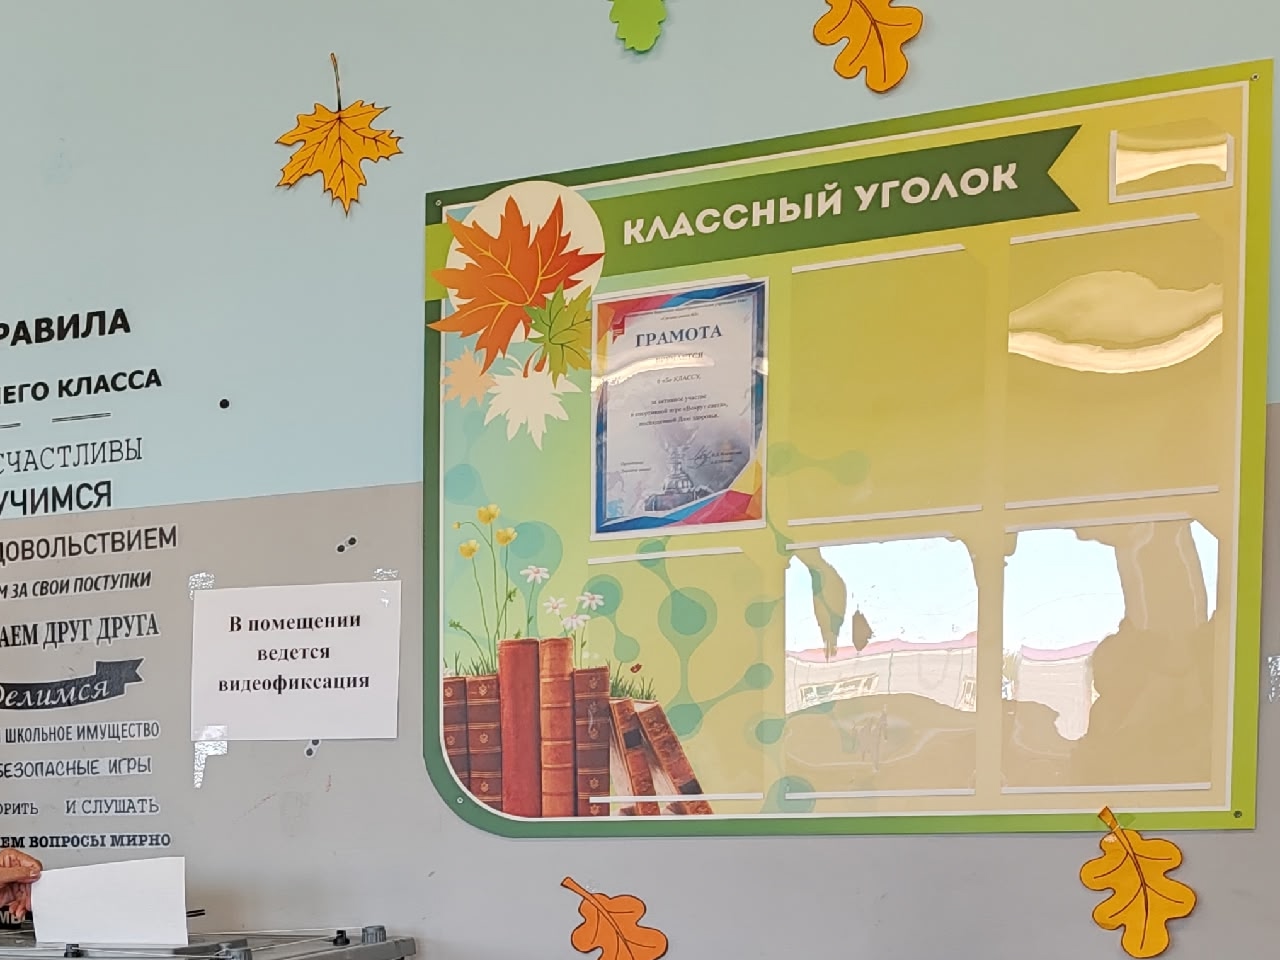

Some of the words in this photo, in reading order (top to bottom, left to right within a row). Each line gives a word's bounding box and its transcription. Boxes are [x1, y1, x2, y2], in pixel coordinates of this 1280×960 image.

[623, 183, 842, 246] КЛАССНЫЙ
[853, 163, 1019, 212] УГОЛОК
[635, 324, 723, 348] ГРАМОТА
[58, 368, 163, 398] КЛАССА
[12, 582, 28, 599] ЗА
[32, 578, 70, 597] СВОИ
[73, 571, 152, 594] ПОСТУПКИ
[43, 618, 93, 649] ДРУГ
[96, 613, 159, 646] ДРУГА
[228, 616, 242, 632] В
[248, 614, 361, 633] помещении
[257, 646, 331, 663] ведется
[219, 674, 370, 695] видеофиксация
[5, 725, 73, 743] ШКОЛЬНОЕ
[77, 722, 160, 742] ИМУЩЕСТВО
[108, 757, 152, 774] ИГРЫ
[65, 800, 76, 814] И
[81, 798, 160, 815] СЛУШАТЬ
[29, 835, 107, 849] ВОПРОСЫ
[110, 833, 171, 847] МИРНО
